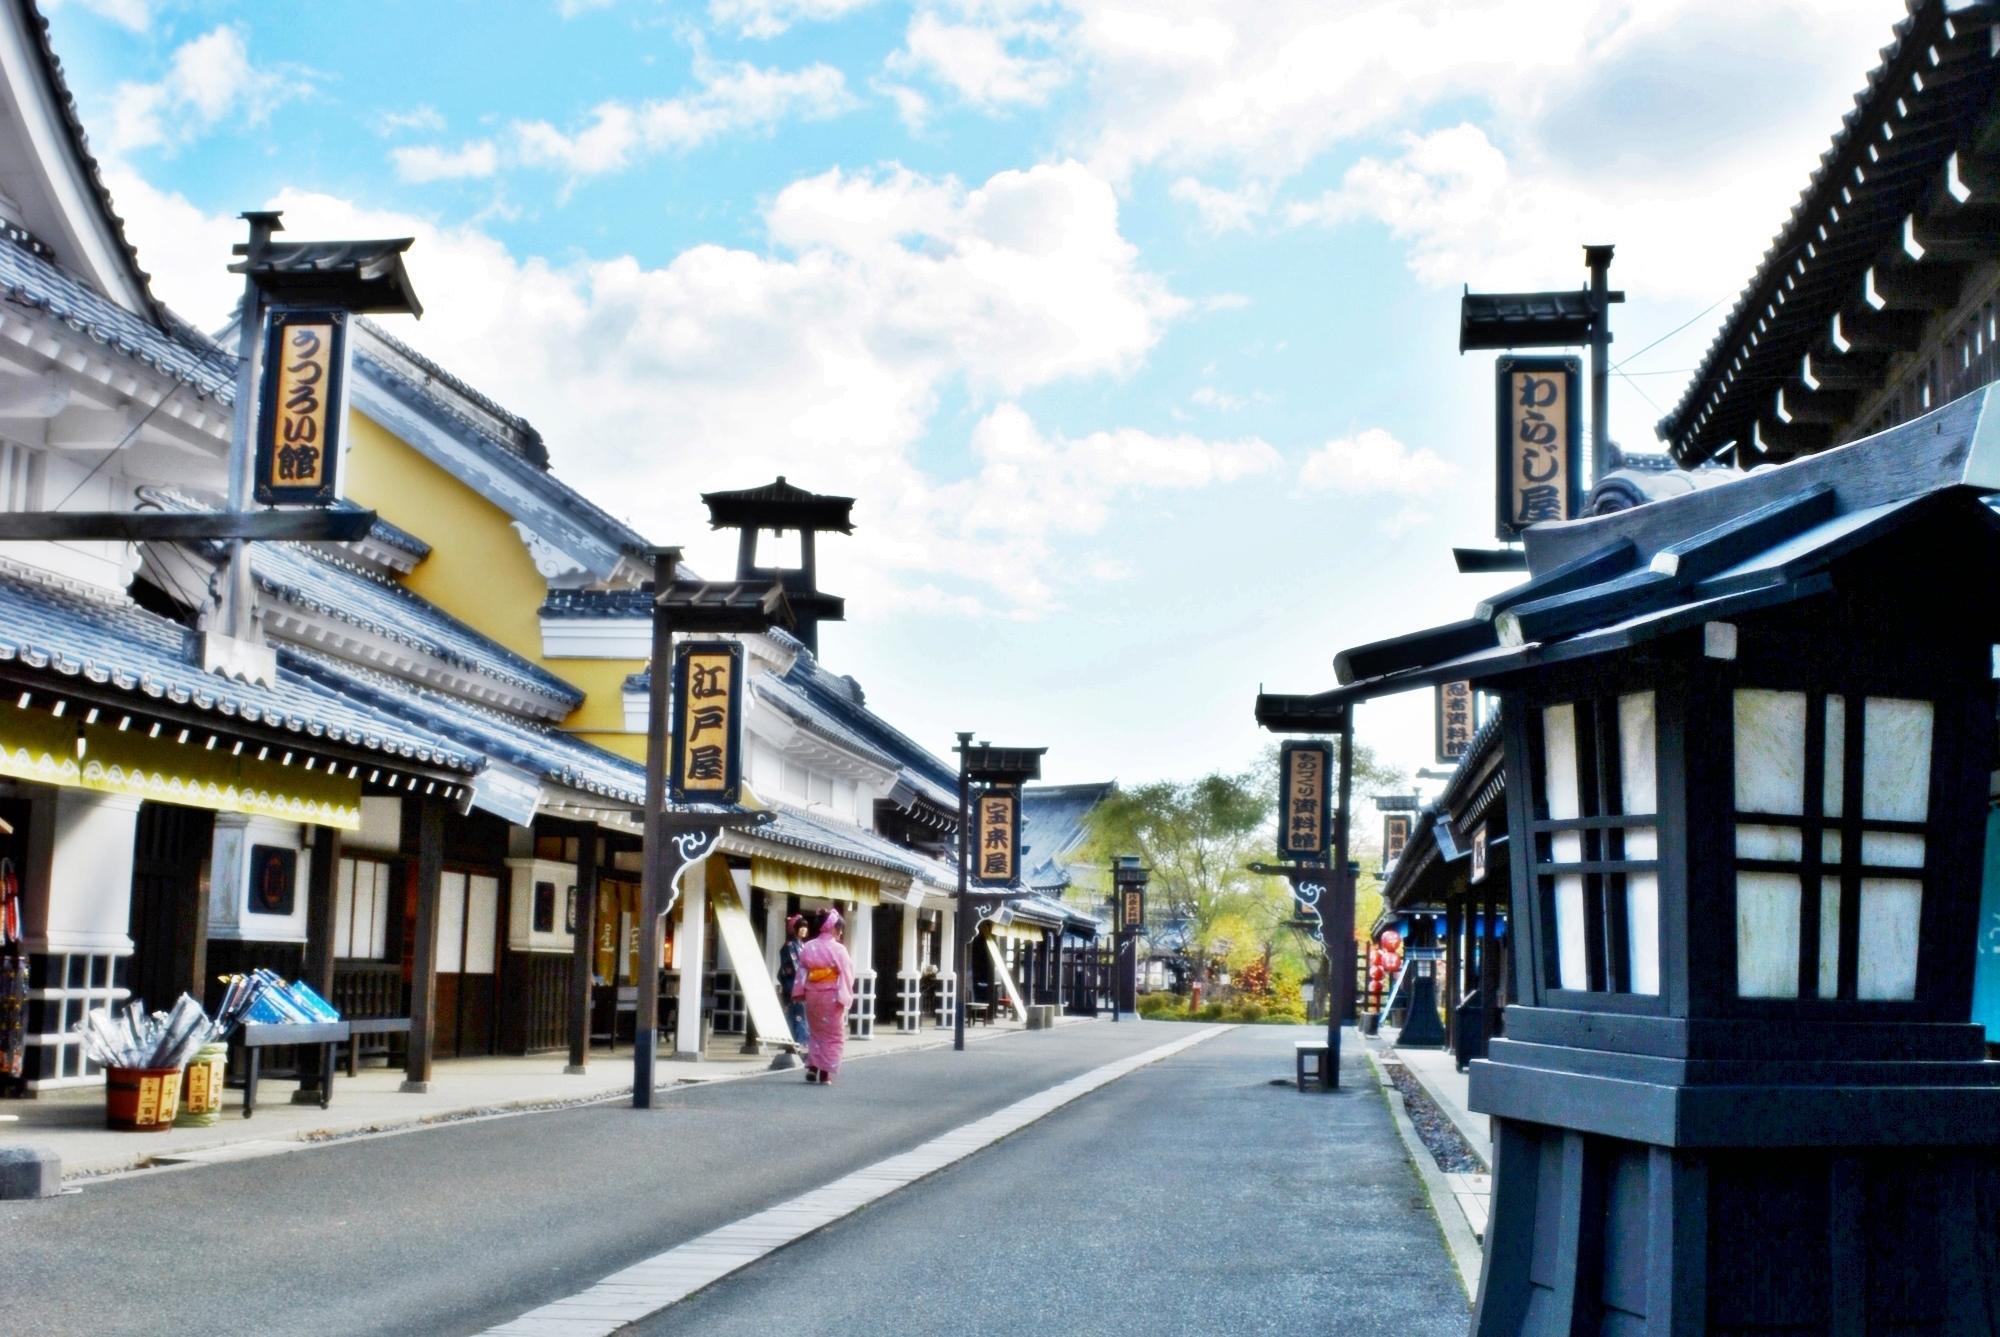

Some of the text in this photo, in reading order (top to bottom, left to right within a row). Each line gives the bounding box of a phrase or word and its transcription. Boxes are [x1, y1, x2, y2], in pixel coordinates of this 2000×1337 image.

[277, 329, 322, 480] うつろい館
[1517, 374, 1561, 521] わらじ屋
[687, 662, 727, 781] 江戸屋
[983, 802, 1009, 874] 宝来屋
[1291, 752, 1318, 849] ものづくり資料館
